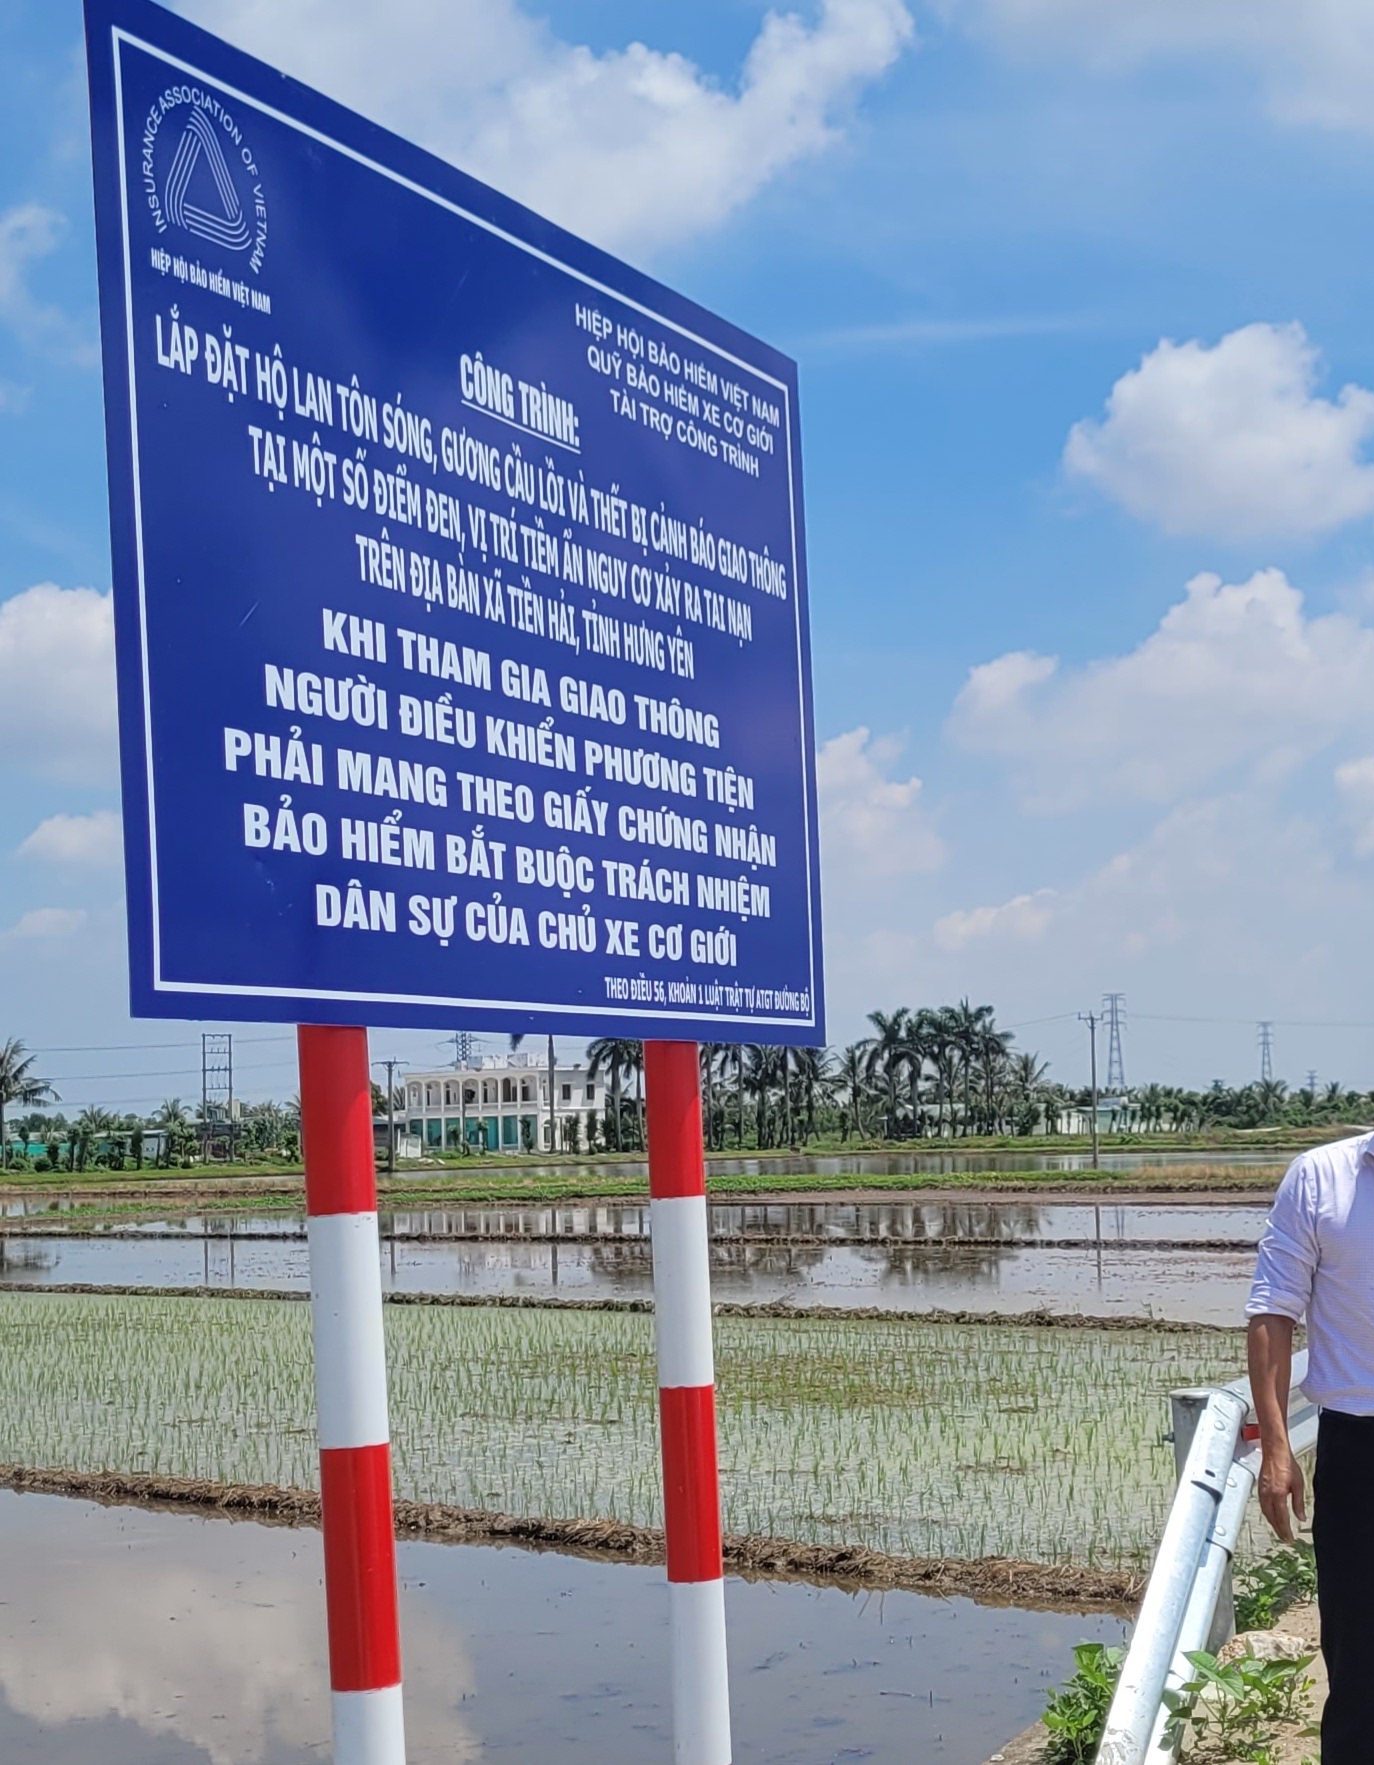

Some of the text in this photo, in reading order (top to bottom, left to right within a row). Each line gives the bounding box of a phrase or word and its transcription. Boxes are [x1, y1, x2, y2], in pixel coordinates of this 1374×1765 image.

[142, 85, 267, 274] INSURANCE ASSOCIATION OF VIETNAM
[151, 247, 171, 276] HIỆP
[173, 255, 188, 284] HỘI
[189, 260, 207, 289] BẢO
[232, 281, 249, 308] VIỆT
[251, 289, 271, 315] NAM
[460, 351, 580, 447] CÔNG TRÌNH:
[575, 303, 612, 341] HIỆP
[617, 324, 644, 359] HỘI
[648, 342, 680, 375] BẢO
[721, 378, 749, 412] VIỆT
[752, 395, 780, 428] NAM
[587, 345, 622, 379] QUỸ
[627, 363, 660, 398] BẢO
[702, 400, 721, 428] XE
[723, 411, 744, 438] CƠ
[747, 425, 774, 455] GIỚI
[156, 303, 787, 600] LẮP ĐẶT HỘ LAN TÔN SÓNG, GƯƠNG CẦU LỒI VÀ THẾT BỊ CẢNH BÁO GIAO THÔNG
[610, 388, 759, 478] TÀI TRỢ CÔNG TRÌNH
[248, 424, 753, 648] TẠI MỘT SỐ ĐIỂM ĐEN, VỊ TRÍ TIỀM ẨN NGUY CƠ XẢY RA TAI NẠN
[355, 526, 695, 680] TRÊN ĐỊA BÀN XÃ TIỀN HẢI, TỈNH HƯNG YÊN
[264, 663, 754, 813] NGƯỜI ĐIỀU KHIỂN PHƯƠNG TIỆN
[322, 607, 720, 749] KHI THAM GIA GIAO THÔNG
[223, 725, 777, 871] PHẢI MANG THEO GIẤY CHỨNG NHẬN
[243, 794, 771, 922] BẢO HIỂM BẮT BUỘC TRÁCH NHIỆM
[315, 878, 737, 967] DÂN SỰ CỦA CHỦ XE CƠ GIỚI
[604, 972, 810, 1017] THEO ĐIỀU 56, KHOẢN 1 LUẬT TRẬT TỰ ATGT ĐƯỜNG BỘ
